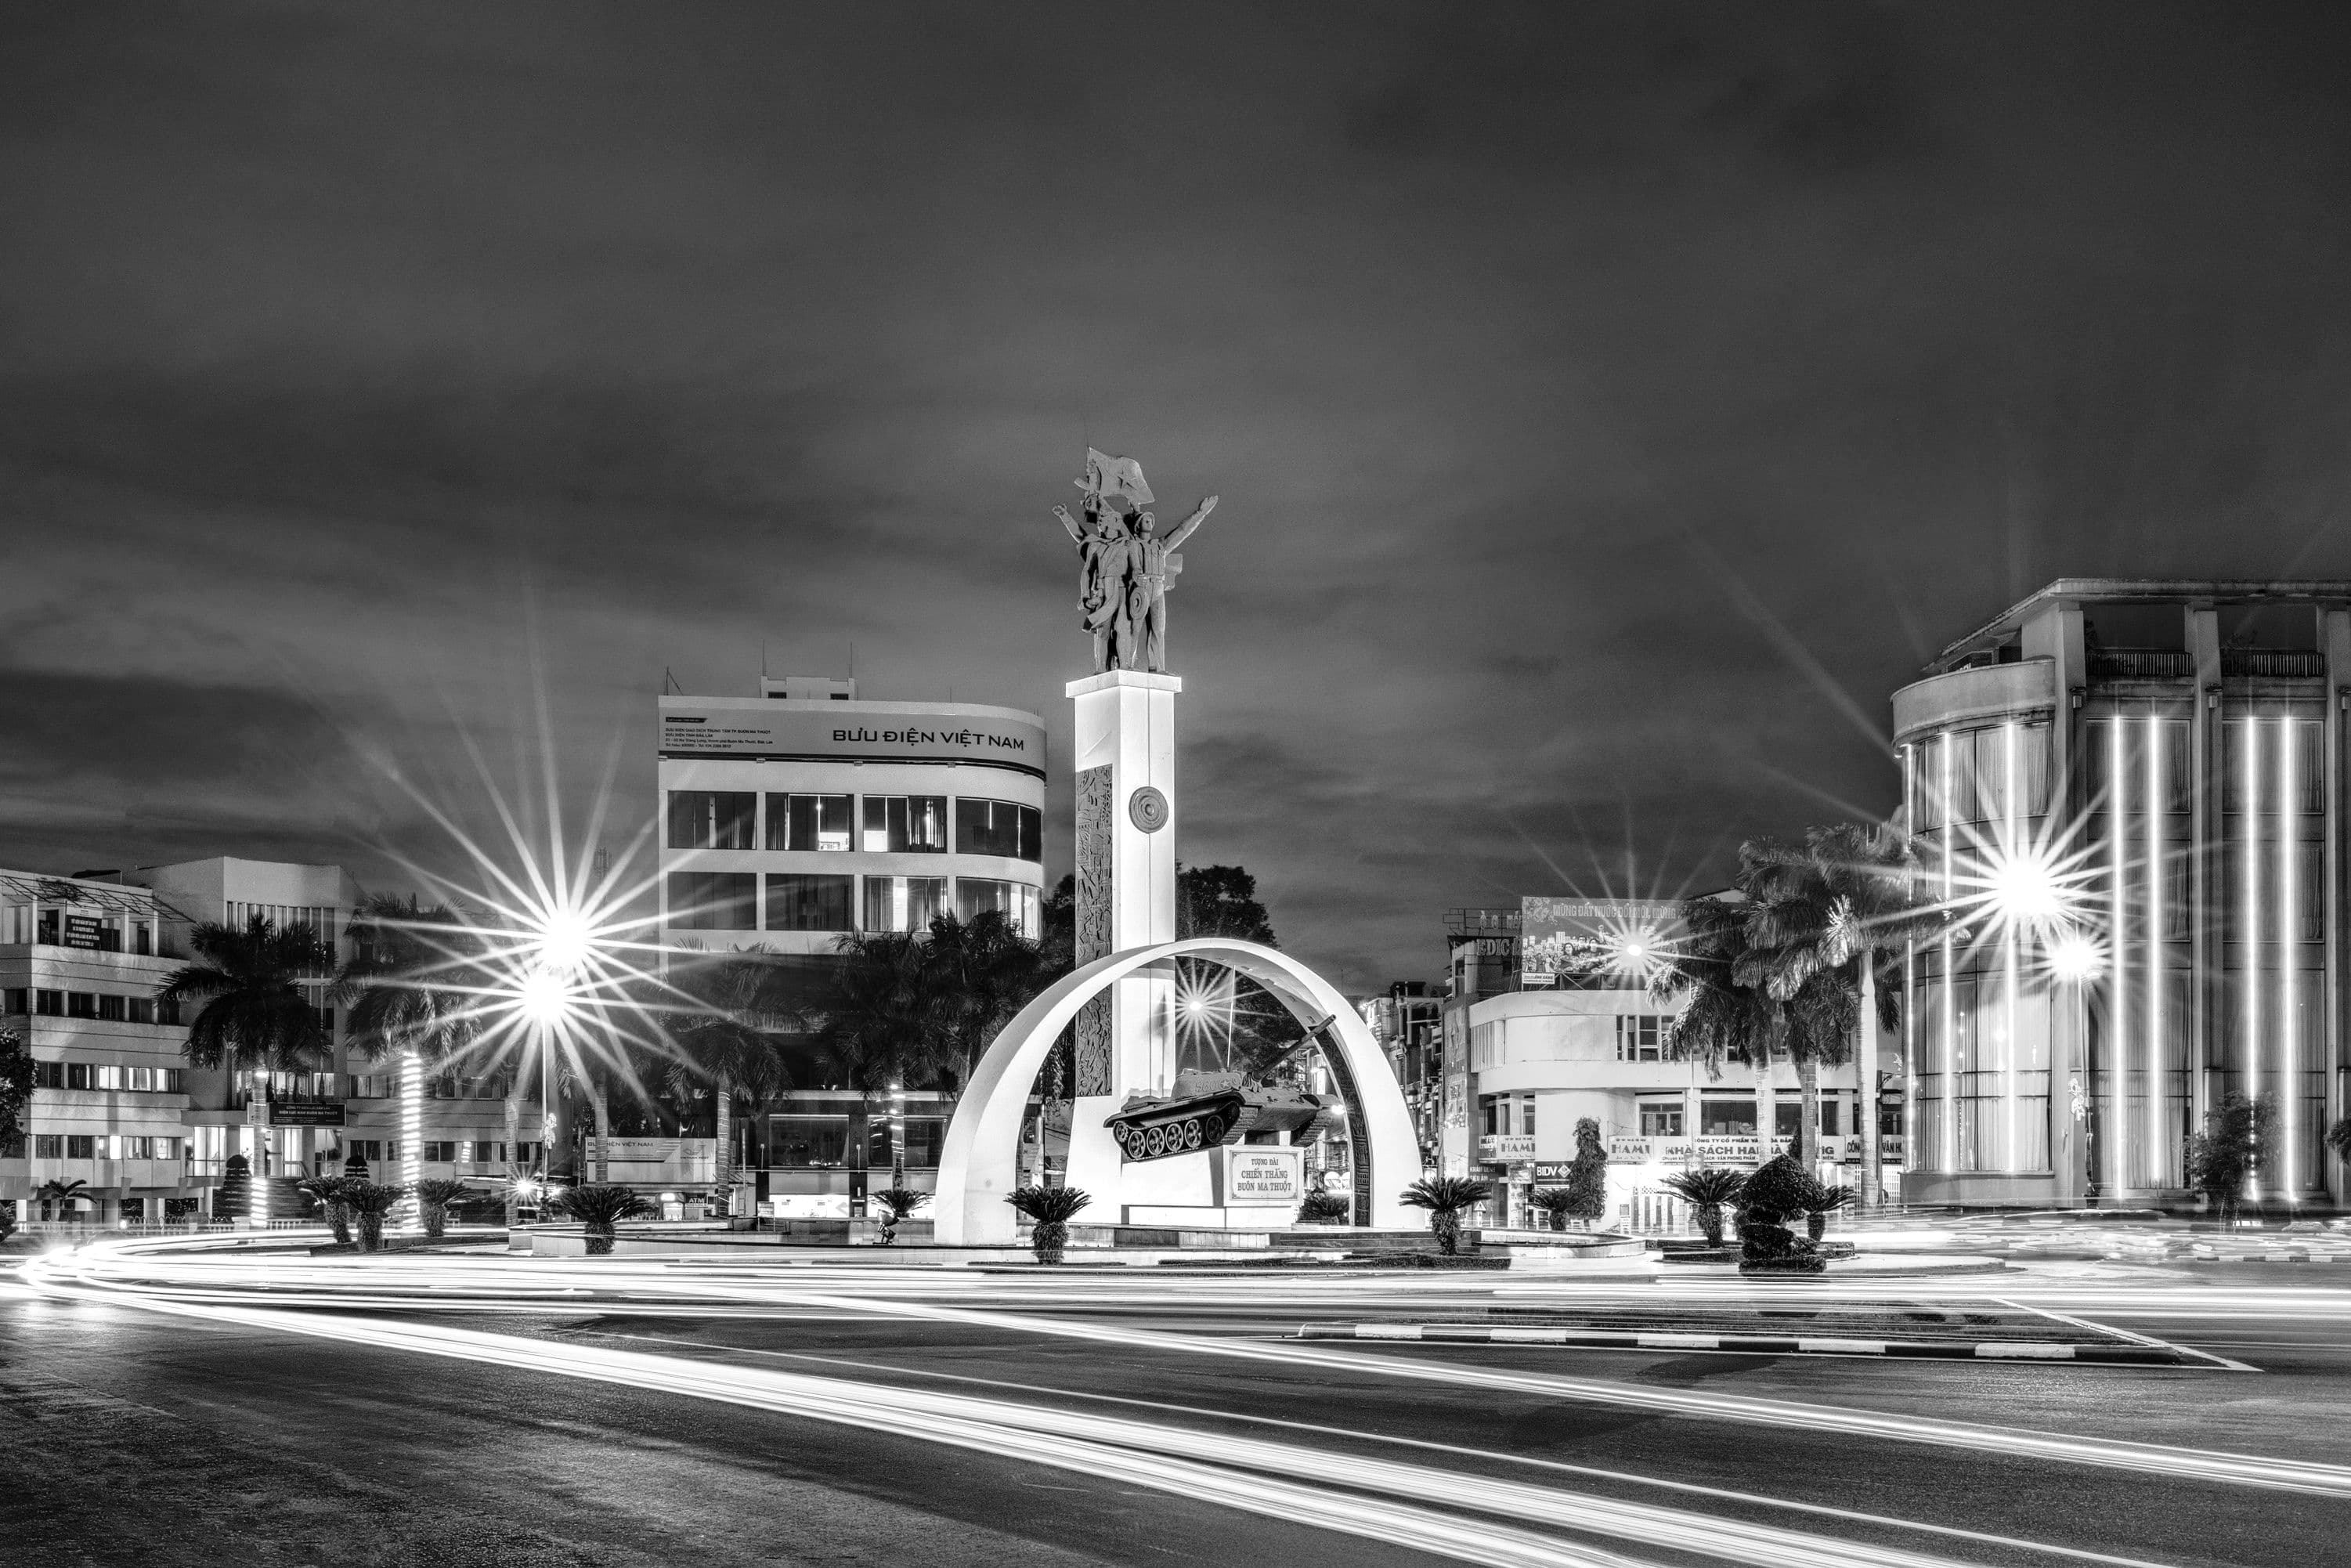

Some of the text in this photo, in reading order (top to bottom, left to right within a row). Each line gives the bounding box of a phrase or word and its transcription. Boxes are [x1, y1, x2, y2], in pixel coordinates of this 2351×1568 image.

[882, 727, 935, 746] ĐIỆN
[941, 728, 984, 747] VIỆT
[988, 735, 1024, 750] NAM
[1553, 902, 1576, 916] MỪNG
[1578, 901, 1594, 917] ĐẤT
[1476, 939, 1510, 956] EDIC
[1666, 1144, 1692, 1154] NHÀ
[1698, 1144, 1734, 1154] SÁCH
[1847, 1140, 1861, 1153] CÔN
[1882, 1140, 1894, 1154] VĂN
[1269, 1157, 1279, 1165] ĐÀI
[1241, 1167, 1288, 1179] CHIẾN THẮNG
[1537, 1165, 1558, 1176] BIDV
[1237, 1180, 1291, 1193] BUÔN MA THUỘT
